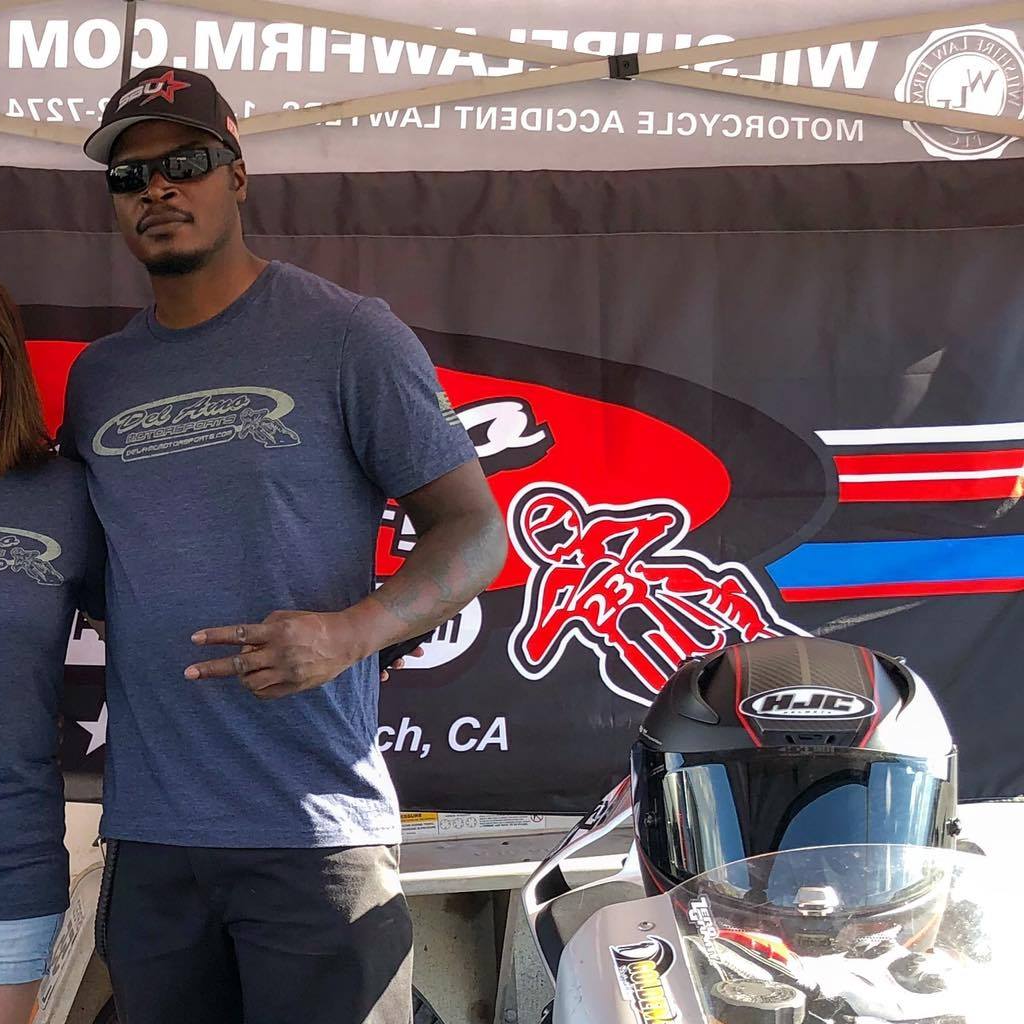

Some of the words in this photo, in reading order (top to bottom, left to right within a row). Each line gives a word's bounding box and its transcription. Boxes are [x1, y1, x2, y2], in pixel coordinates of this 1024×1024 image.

[116, 405, 174, 434] Del
[172, 395, 251, 424] Amo
[585, 573, 637, 625] 23
[760, 693, 855, 712] HJC
[448, 716, 510, 752] CA
